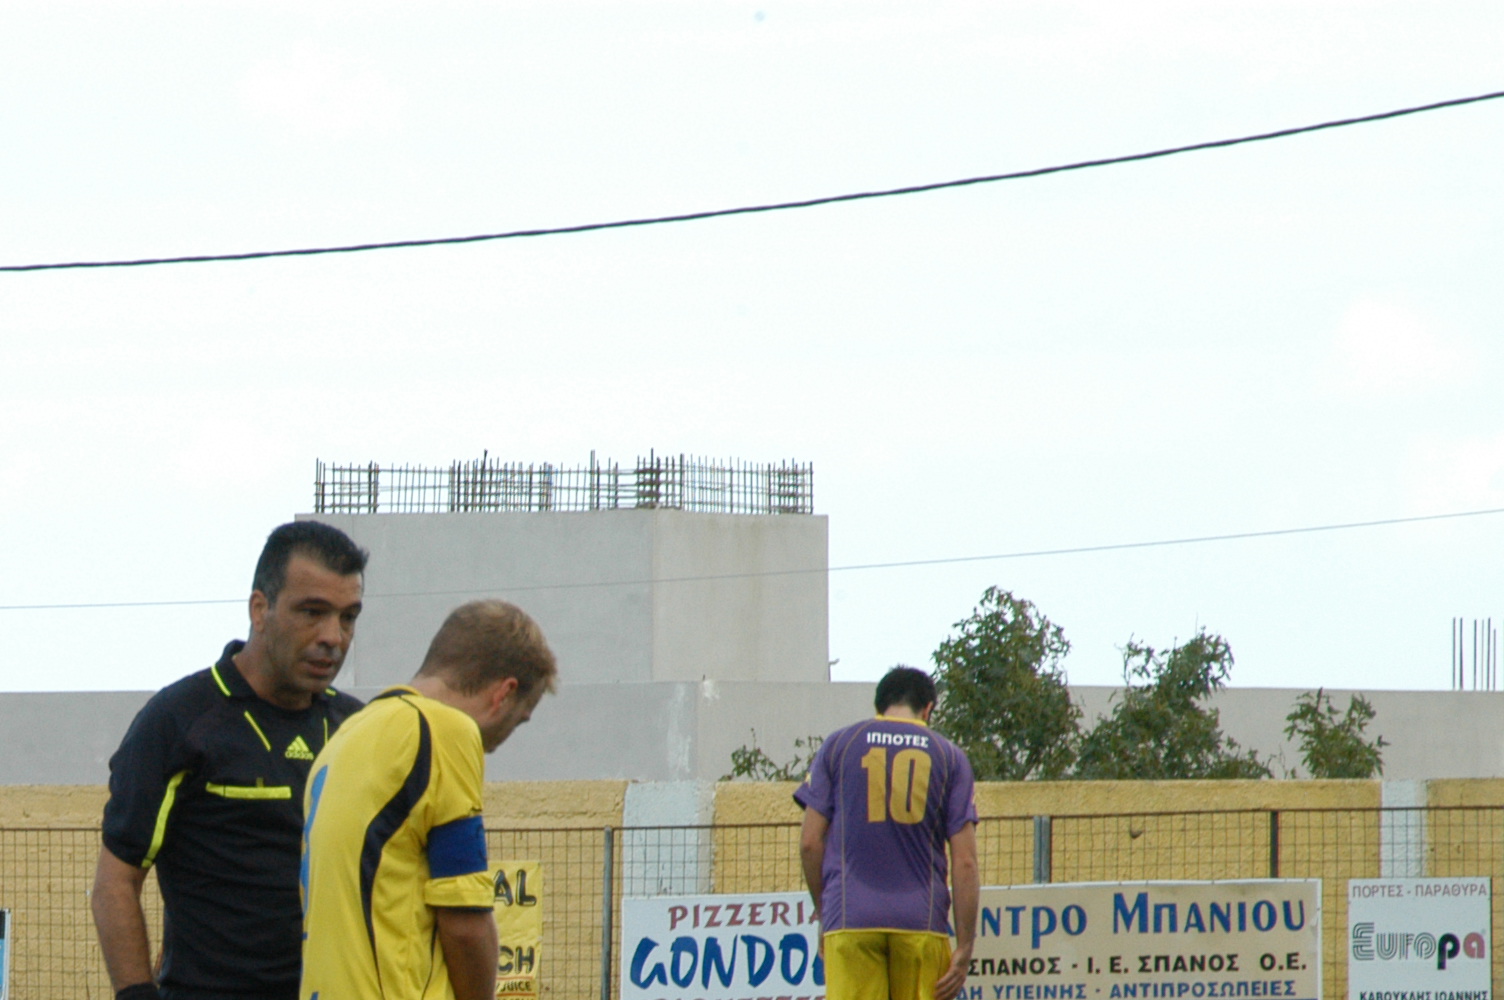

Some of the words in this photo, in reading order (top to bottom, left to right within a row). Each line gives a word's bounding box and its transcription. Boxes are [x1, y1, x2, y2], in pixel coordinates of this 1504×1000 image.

[867, 732, 929, 748] ΙΠΠΟΤΕΣ
[861, 747, 931, 824] 10
[494, 869, 537, 907] AL
[1352, 884, 1404, 898] ΠΟΡΤΕΣ
[1415, 884, 1487, 897] ΠΑΡΑΘΥΡΑ
[1352, 922, 1485, 970] Europa
[498, 946, 535, 975] CH
[967, 957, 1061, 976] ΣΠΑΝΟΣ
[1138, 954, 1240, 973] ΣΠΑΝΟΣ
[1260, 952, 1307, 972] Ο.Ε.
[957, 984, 983, 1000] ΔΗ
[993, 983, 1087, 1000] ΥΓΙΕΙΝΗΣ
[1110, 979, 1297, 999] ΑΝΤΙΠΡΟΣΩΠΕΙΕΣ
